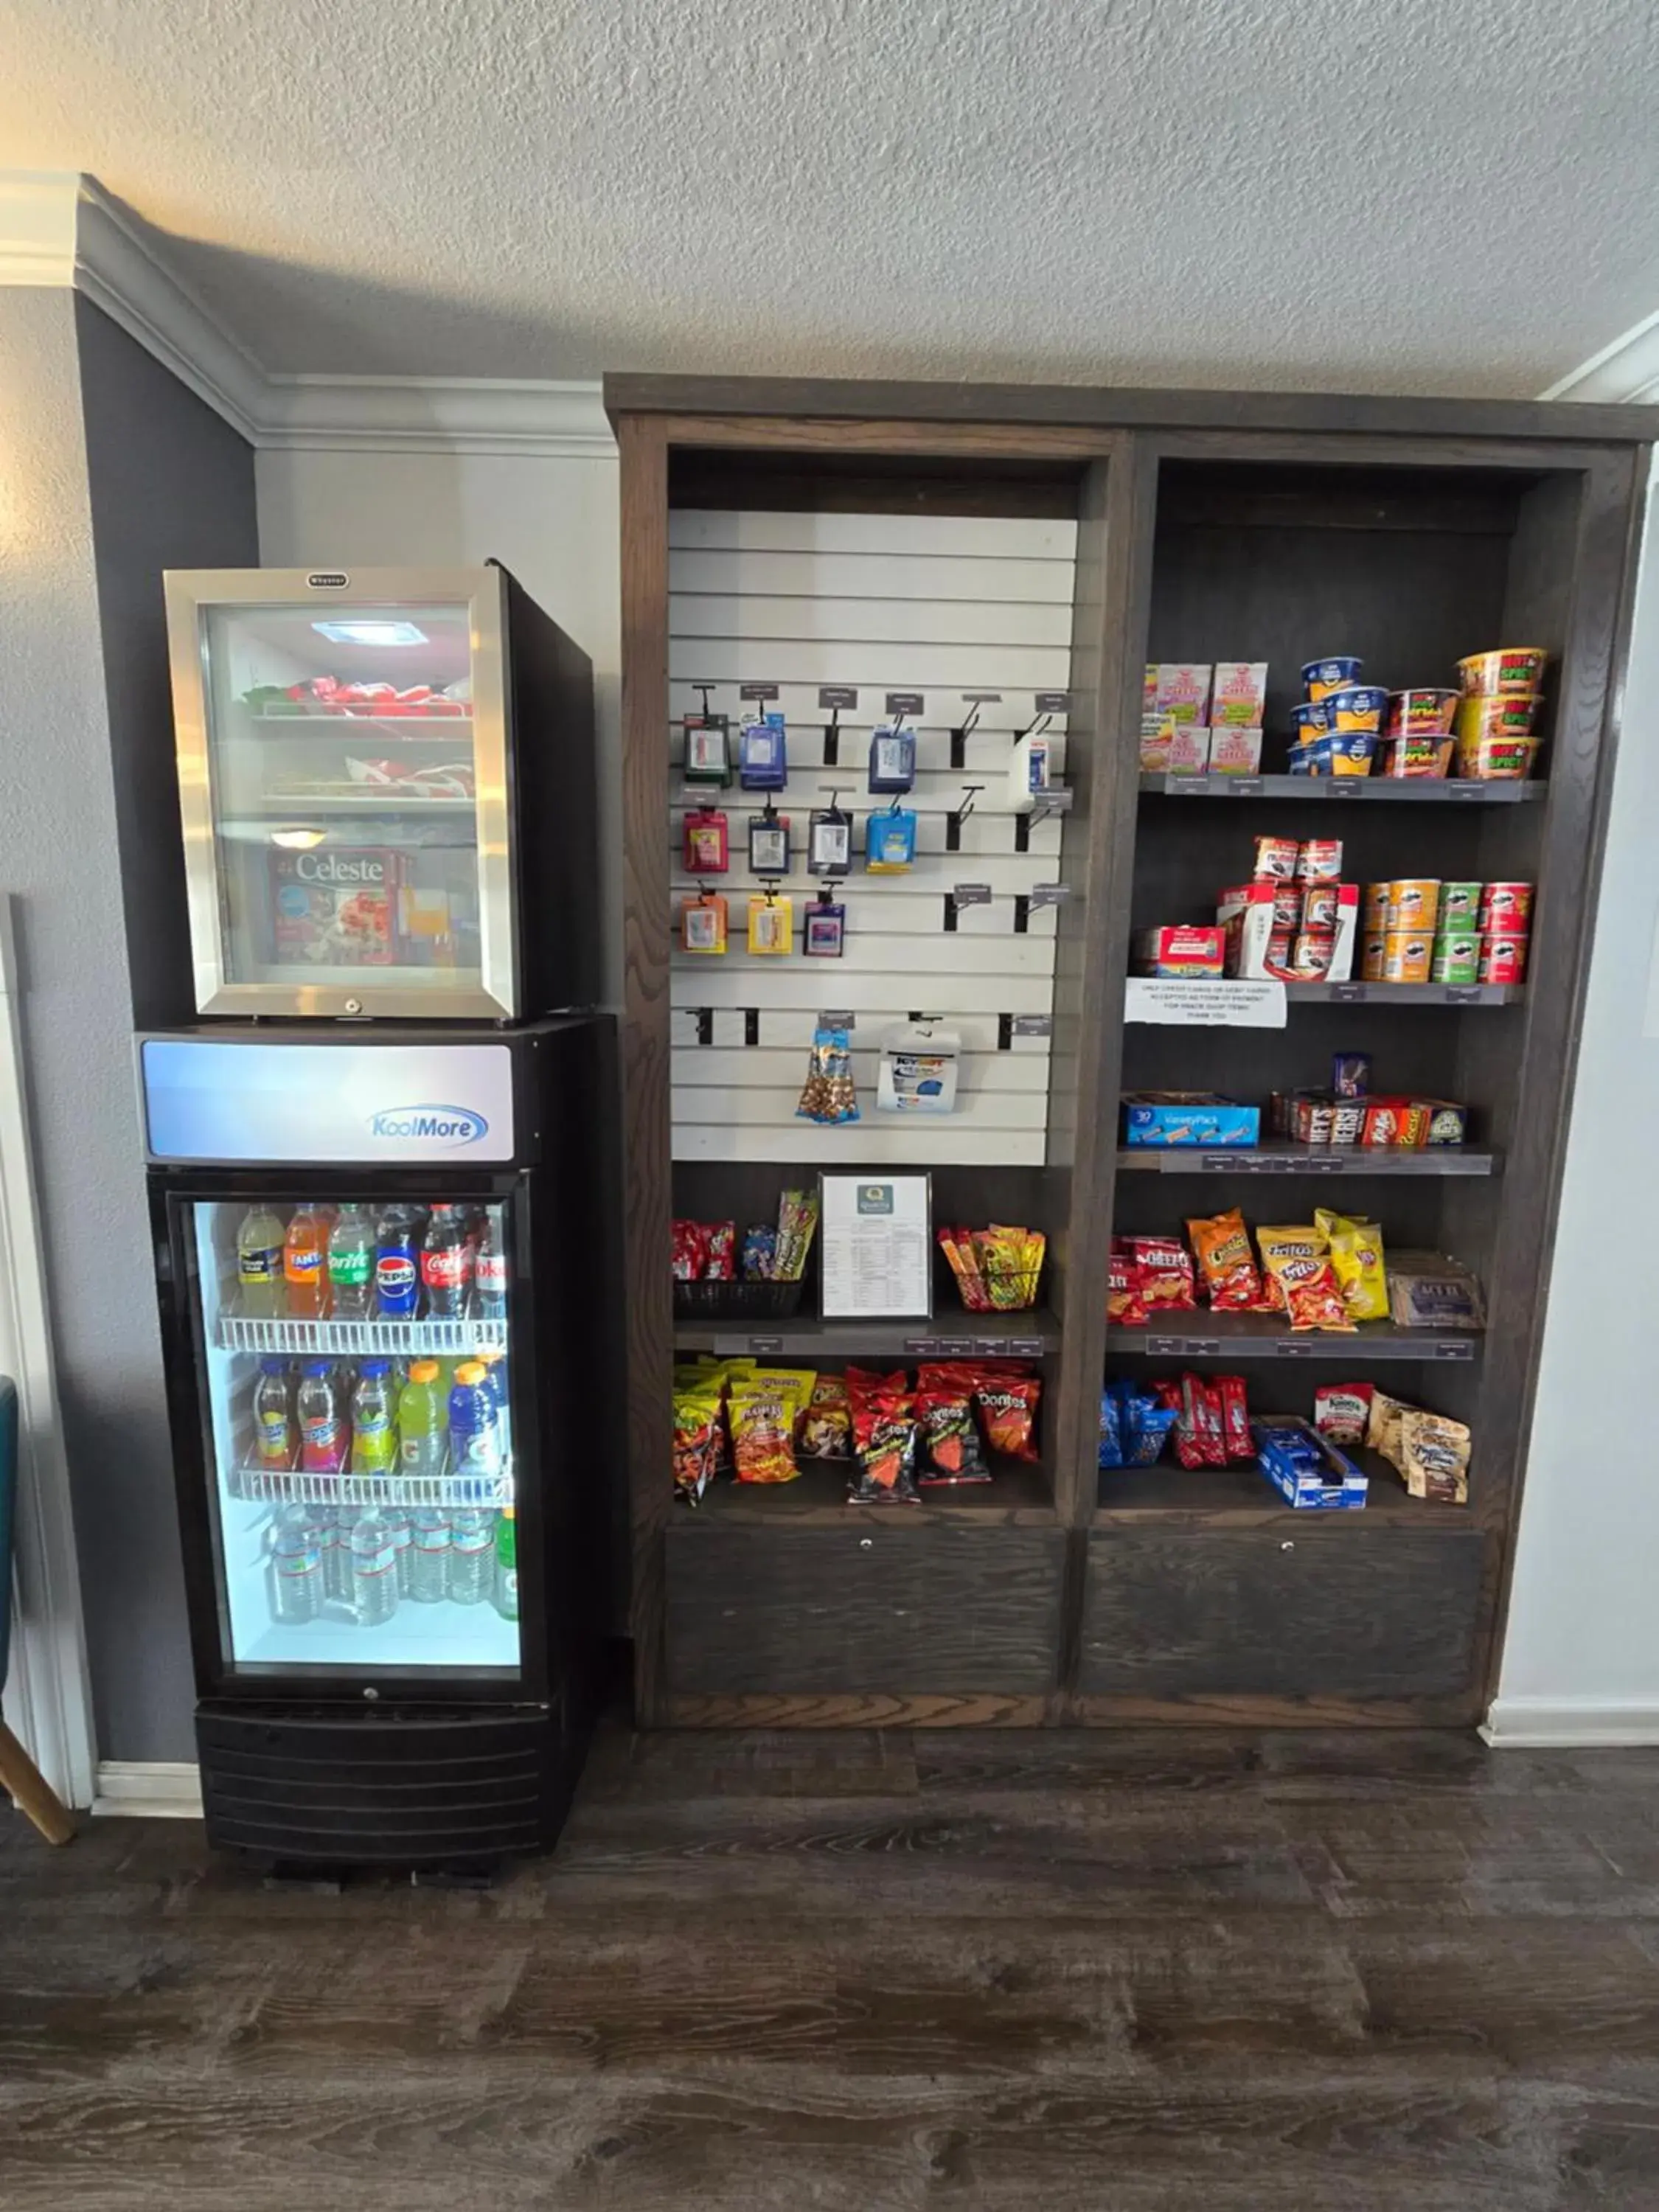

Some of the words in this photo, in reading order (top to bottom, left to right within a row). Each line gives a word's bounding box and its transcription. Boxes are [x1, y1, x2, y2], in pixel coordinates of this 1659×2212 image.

[296, 853, 383, 881] Celeste
[372, 1116, 471, 1138] KoolMore
[978, 1394, 1027, 1409] Doritos
